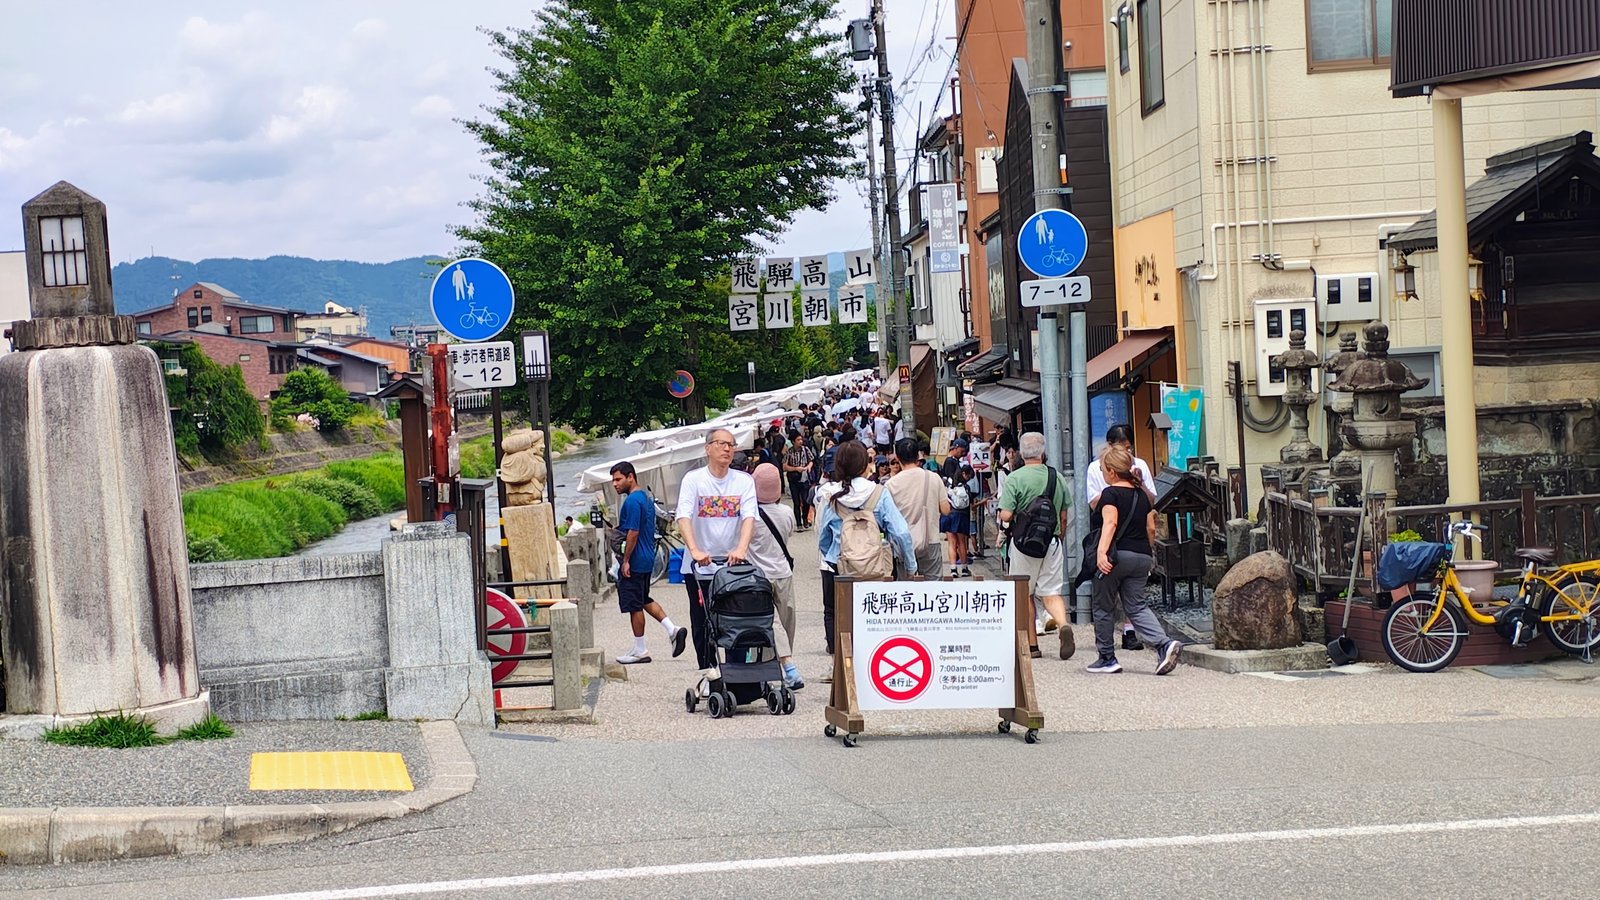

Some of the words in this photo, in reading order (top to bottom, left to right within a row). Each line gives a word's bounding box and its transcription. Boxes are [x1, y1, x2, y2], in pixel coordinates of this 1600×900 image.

[733, 256, 872, 289] 飛騨高山
[1029, 282, 1082, 301] 7-12
[730, 291, 864, 327] 宮川朝市
[449, 346, 511, 365] 車・歩行者用道路
[453, 366, 502, 382] -12
[973, 452, 989, 460] 入口
[861, 590, 1008, 615] 飛騨高山宮川朝市
[954, 617, 980, 625] Morning
[940, 645, 971, 653] 営業時間
[889, 678, 914, 687] 通行止
